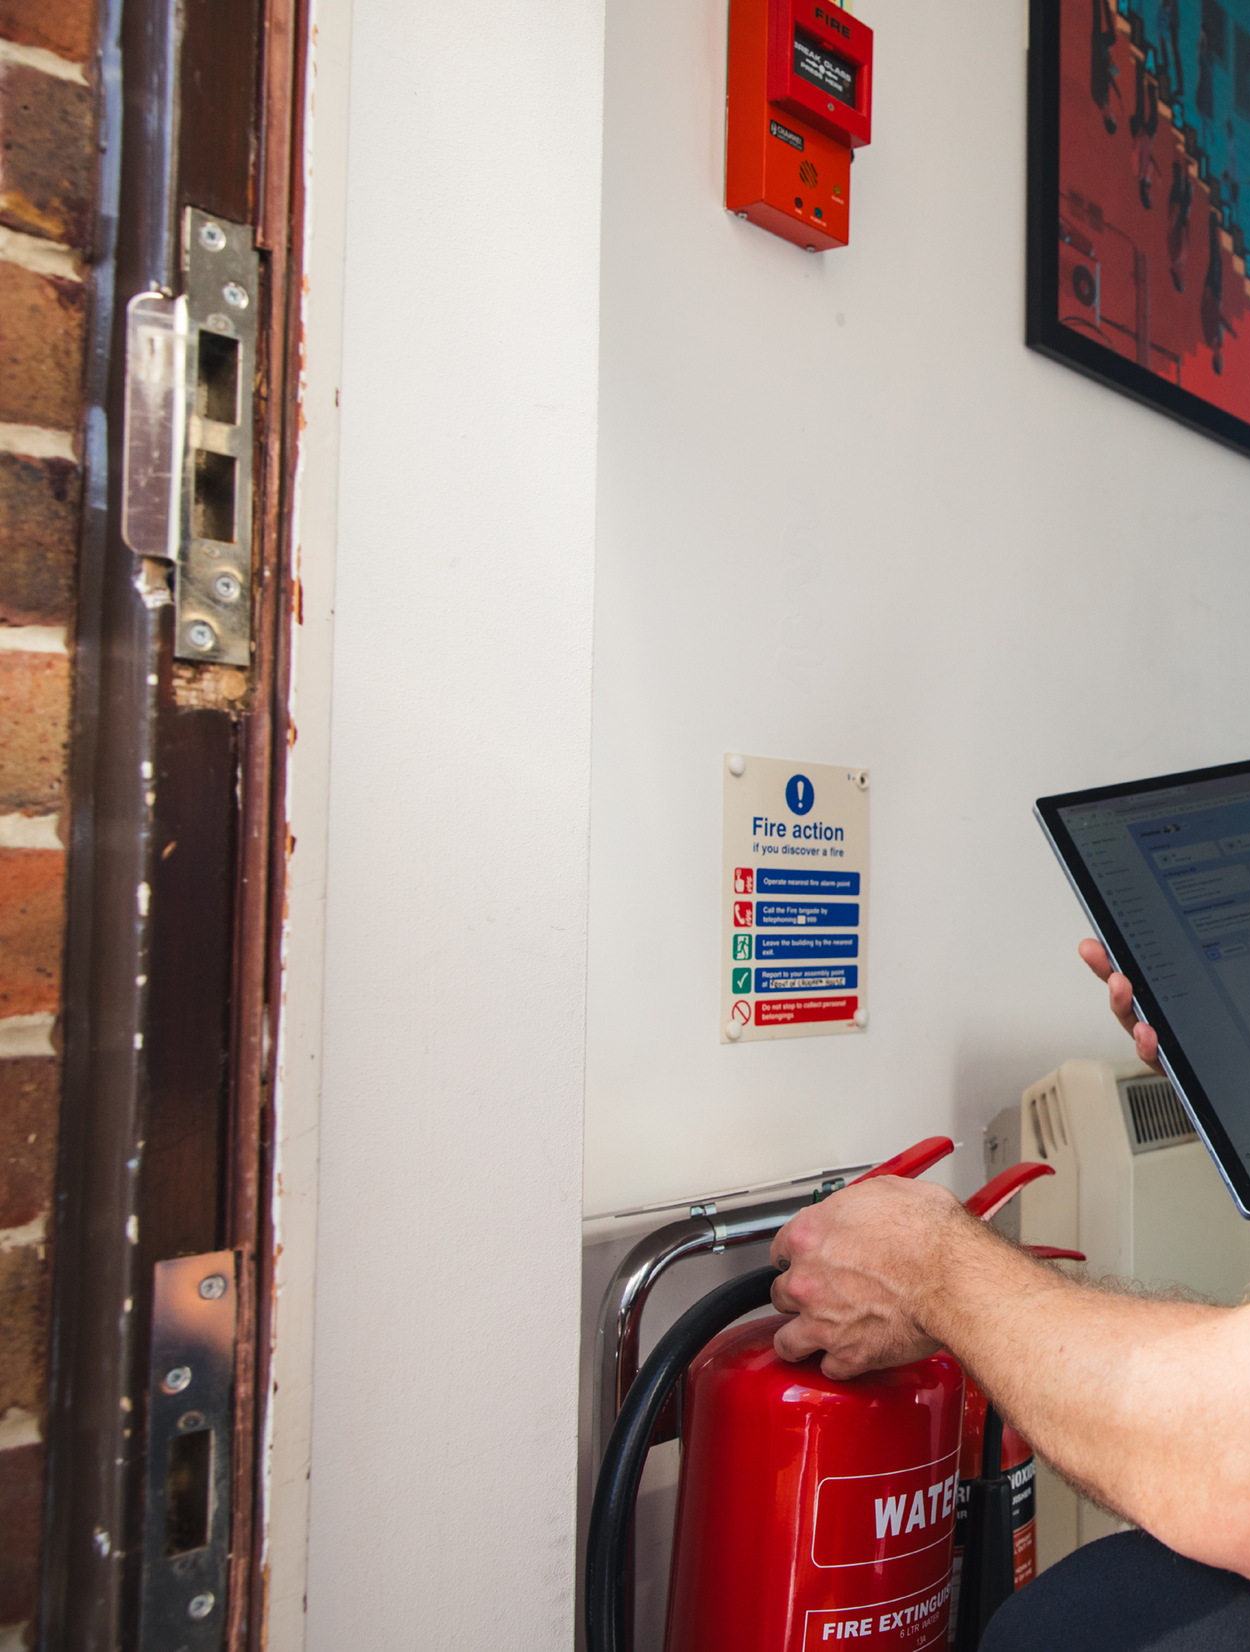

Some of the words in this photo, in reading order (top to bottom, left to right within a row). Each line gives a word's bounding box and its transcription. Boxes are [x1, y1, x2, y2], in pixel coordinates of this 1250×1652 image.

[815, 6, 851, 40] FIRE
[794, 41, 821, 63] BREAK
[823, 60, 852, 82] GLASS
[800, 61, 823, 80] PRESS
[825, 77, 843, 92] HERE
[752, 816, 787, 838] Fire
[792, 821, 844, 841] action
[753, 842, 759, 853] if
[761, 845, 779, 856] you
[781, 844, 820, 856] discover
[822, 848, 828, 857] a
[830, 847, 844, 857] fire
[763, 877, 787, 886] Operate
[836, 880, 851, 888] point
[763, 906, 775, 914] Call
[776, 906, 785, 914] the
[798, 907, 820, 915] brigade
[763, 916, 797, 924] telephoning
[762, 939, 780, 947] Leave
[791, 939, 814, 947] building
[815, 939, 822, 947] by
[762, 971, 782, 979] Report
[790, 971, 803, 979] your
[804, 970, 830, 978] assembly
[831, 969, 845, 977] point
[762, 1003, 771, 1011] Do
[772, 1003, 782, 1011] not
[782, 1002, 795, 1010] stop
[803, 1001, 822, 1009] collect
[822, 1000, 847, 1009] personal
[761, 1013, 795, 1021] belongings
[822, 1618, 873, 1641] FIRE
[879, 1580, 952, 1632] EXTINGUIS
[899, 1629, 905, 1639] 6
[906, 1623, 919, 1637] LTR
[922, 1611, 940, 1630] WATER
[916, 1635, 926, 1647] 13A
